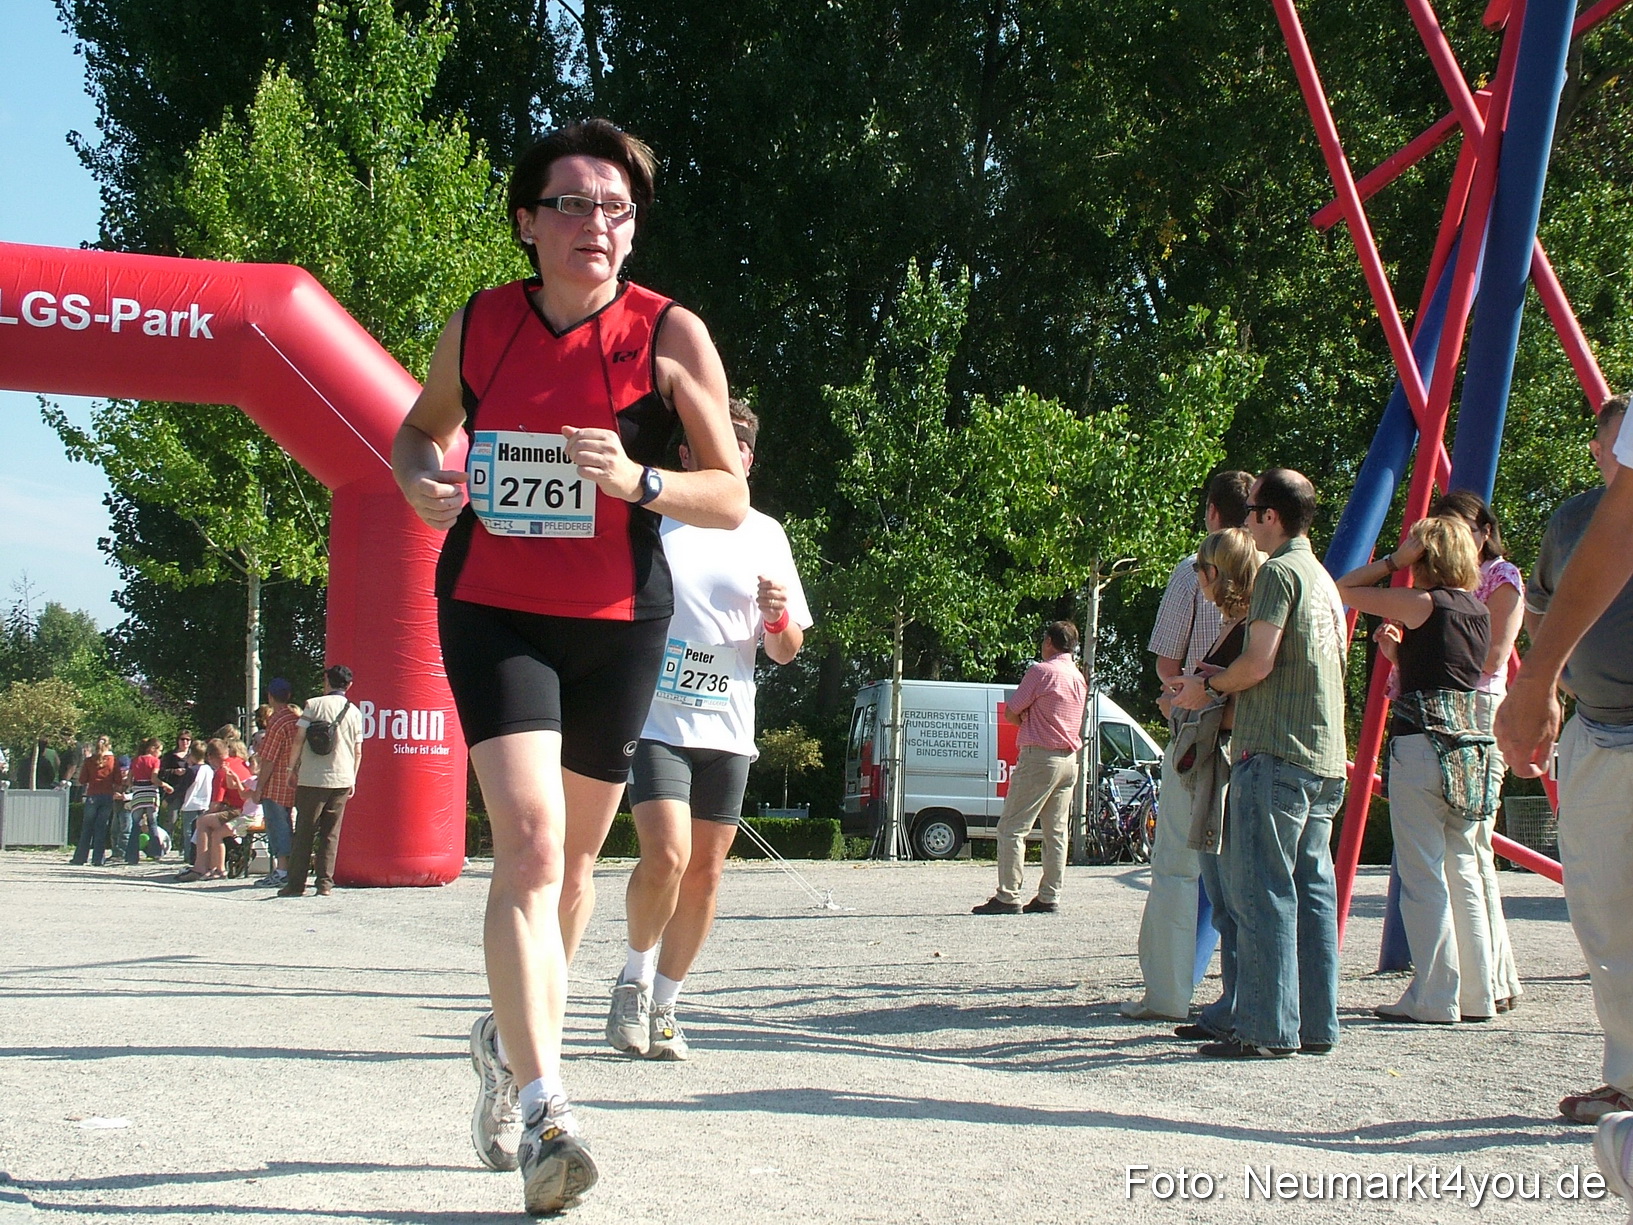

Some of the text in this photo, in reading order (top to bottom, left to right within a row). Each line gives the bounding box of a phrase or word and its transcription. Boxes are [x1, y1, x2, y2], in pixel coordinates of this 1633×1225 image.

[498, 443, 576, 464] Hannelo
[474, 469, 486, 485] D
[499, 477, 582, 509] 2761
[544, 522, 592, 531] PFLEIDERER
[685, 648, 714, 664] Peter
[666, 662, 675, 672] D
[680, 670, 729, 693] 2736
[359, 700, 445, 741] Braun
[393, 743, 450, 756] Sicher ist sicher
[905, 738, 979, 749] NSCHLAGKETTEN
[916, 748, 979, 759] BINDESTRICKE
